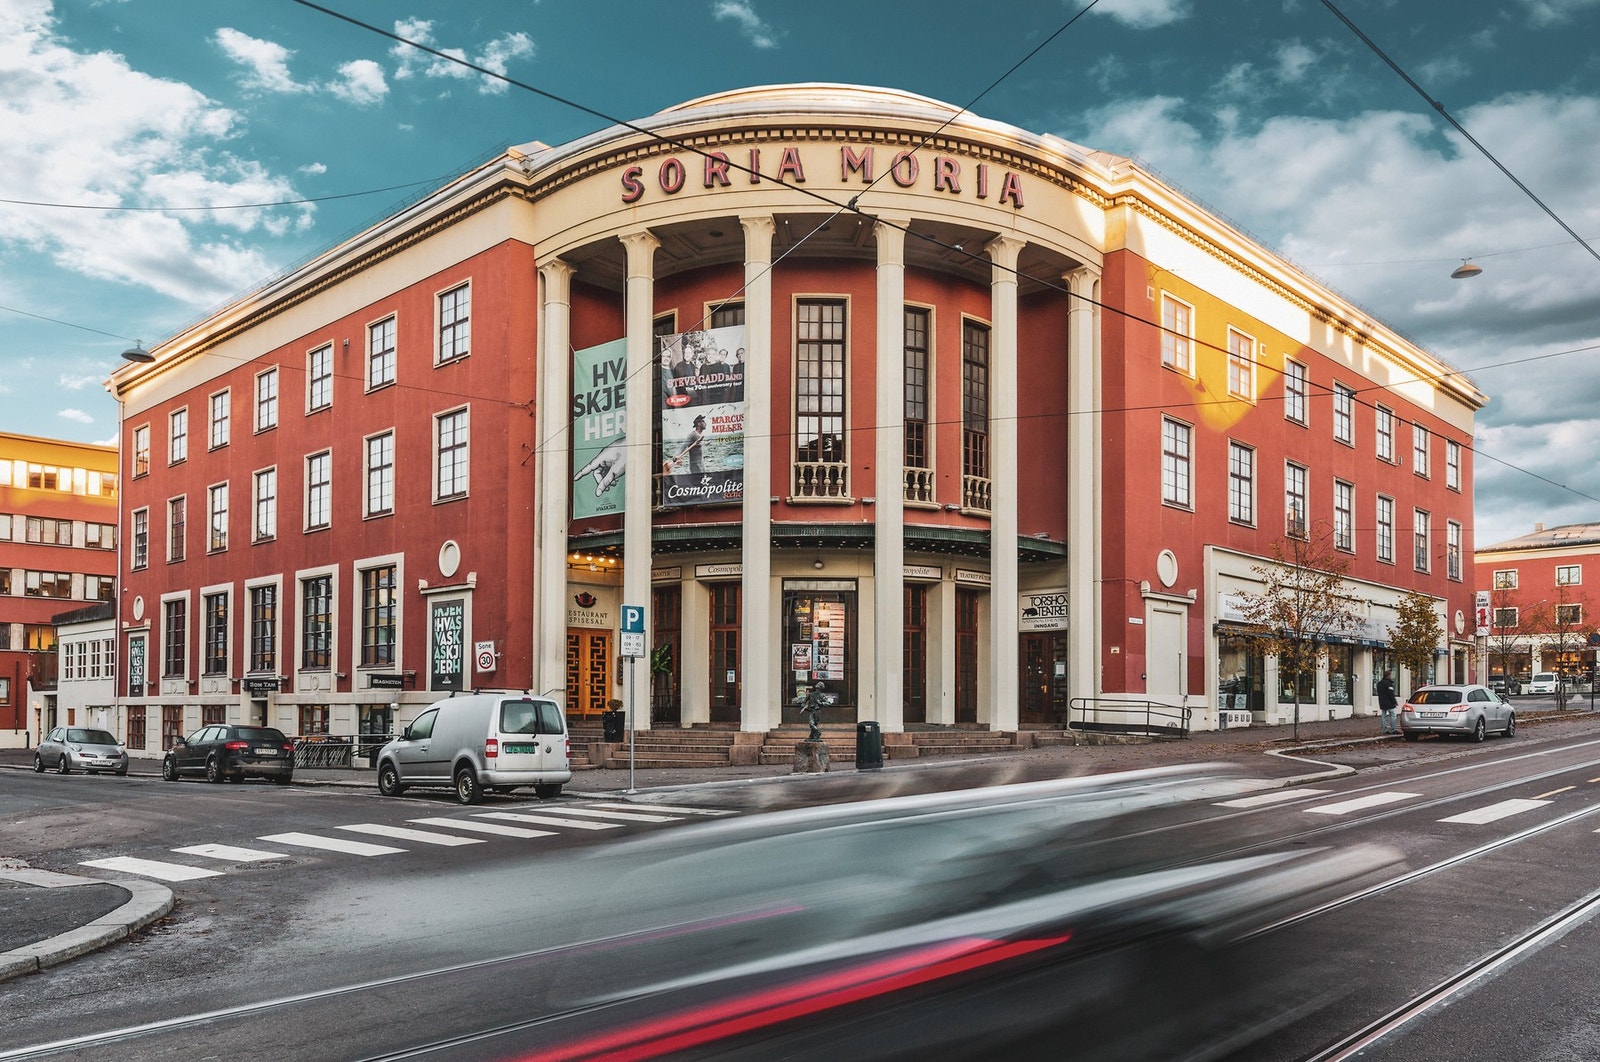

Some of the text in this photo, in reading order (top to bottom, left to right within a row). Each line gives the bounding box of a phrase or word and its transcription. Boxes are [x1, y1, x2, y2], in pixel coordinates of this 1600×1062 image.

[621, 146, 1024, 208] SORIA MORIA
[667, 372, 743, 388] STEVE GADD BAND
[574, 384, 627, 418] SKJE
[712, 424, 743, 433] MILLER
[668, 479, 743, 498] Cosmopolite
[708, 565, 743, 574] Cosmopoli
[568, 609, 608, 619] ESTAURANT
[1037, 605, 1068, 616] TEATRET
[569, 617, 604, 625] SPISESAL
[626, 608, 640, 630] P
[481, 656, 491, 665] 30
